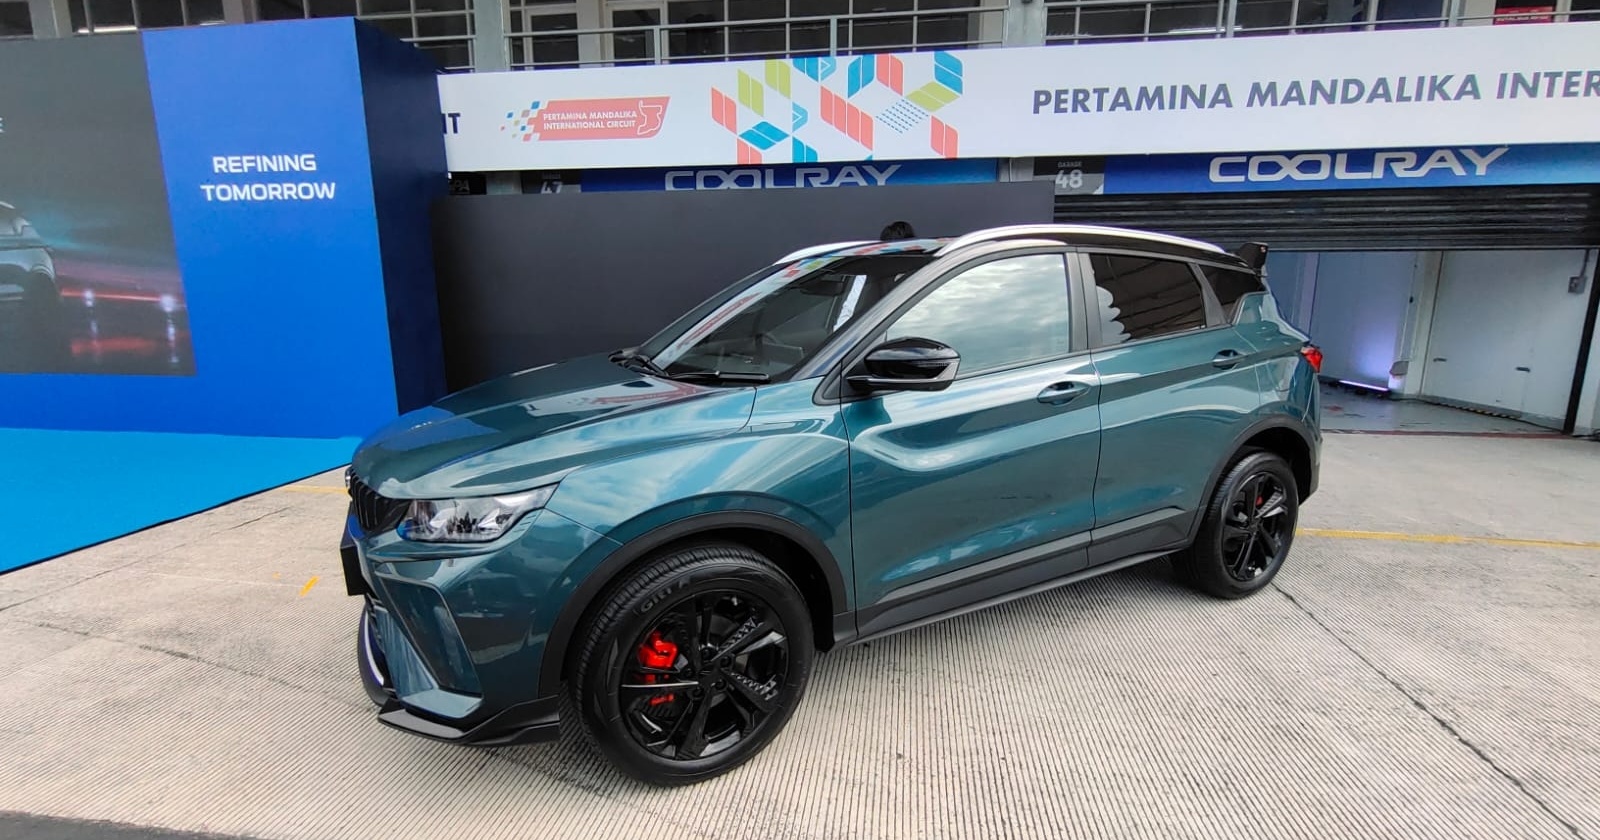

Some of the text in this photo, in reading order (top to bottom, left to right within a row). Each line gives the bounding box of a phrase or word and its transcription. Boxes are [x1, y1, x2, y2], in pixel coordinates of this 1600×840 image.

[1033, 70, 1600, 114] PERTAMINA MANDALIKA INTER
[543, 110, 637, 121] PERTAMINA MANDALIKA
[543, 119, 636, 131] INTERNATIONAL CIRCUIT
[212, 153, 317, 173] REFINING
[1208, 147, 1511, 183] COOLRAY
[541, 181, 563, 194] 47
[664, 164, 902, 191] COOLRAY
[1055, 169, 1083, 189] 48
[200, 182, 336, 201] TOMORROW
